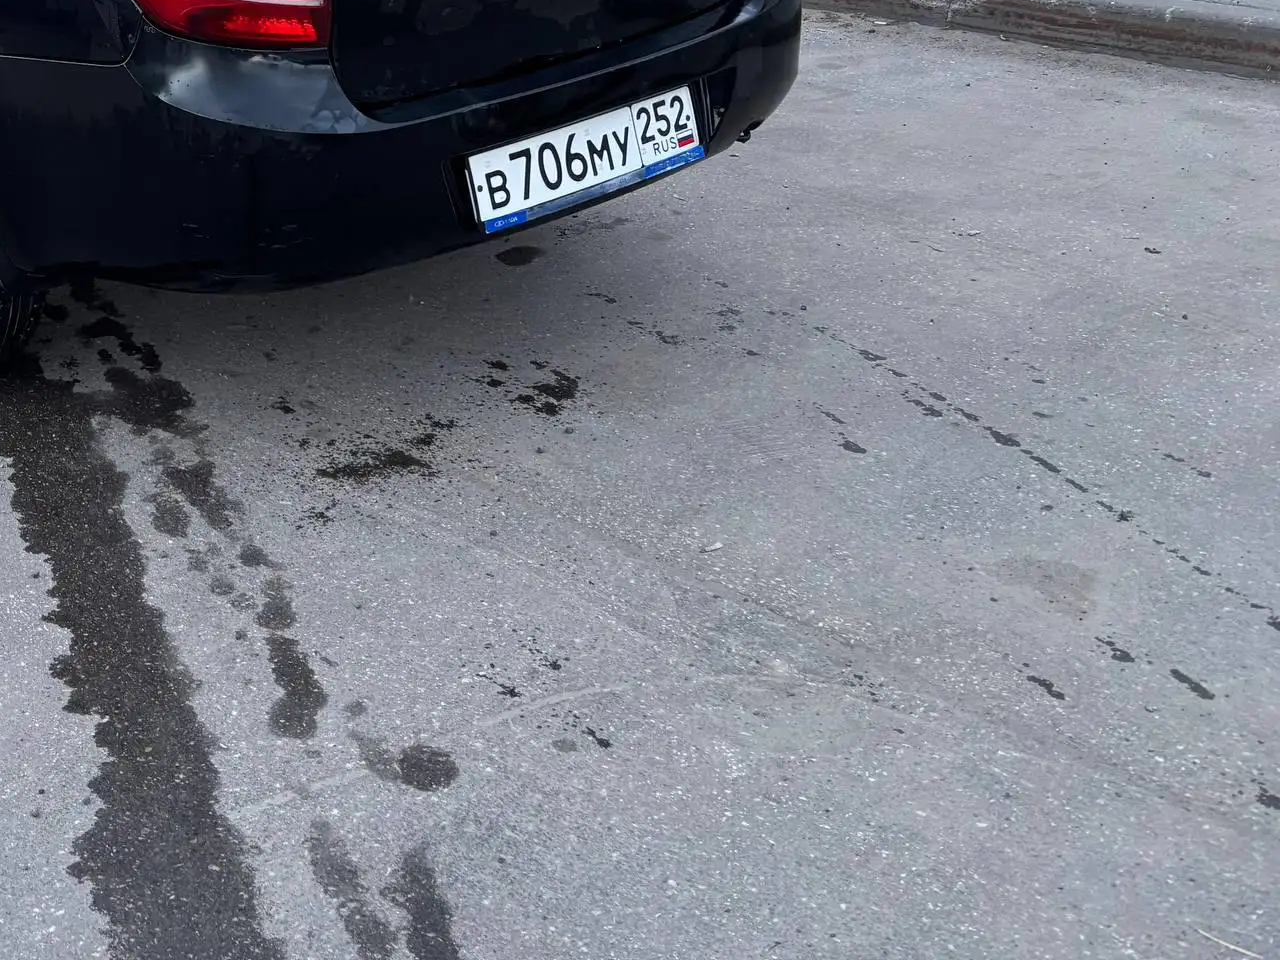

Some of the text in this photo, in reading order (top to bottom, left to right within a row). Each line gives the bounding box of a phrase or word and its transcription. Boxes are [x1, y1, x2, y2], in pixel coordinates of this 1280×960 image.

[485, 96, 688, 210] В706МУ 252
[652, 136, 677, 156] RUS
